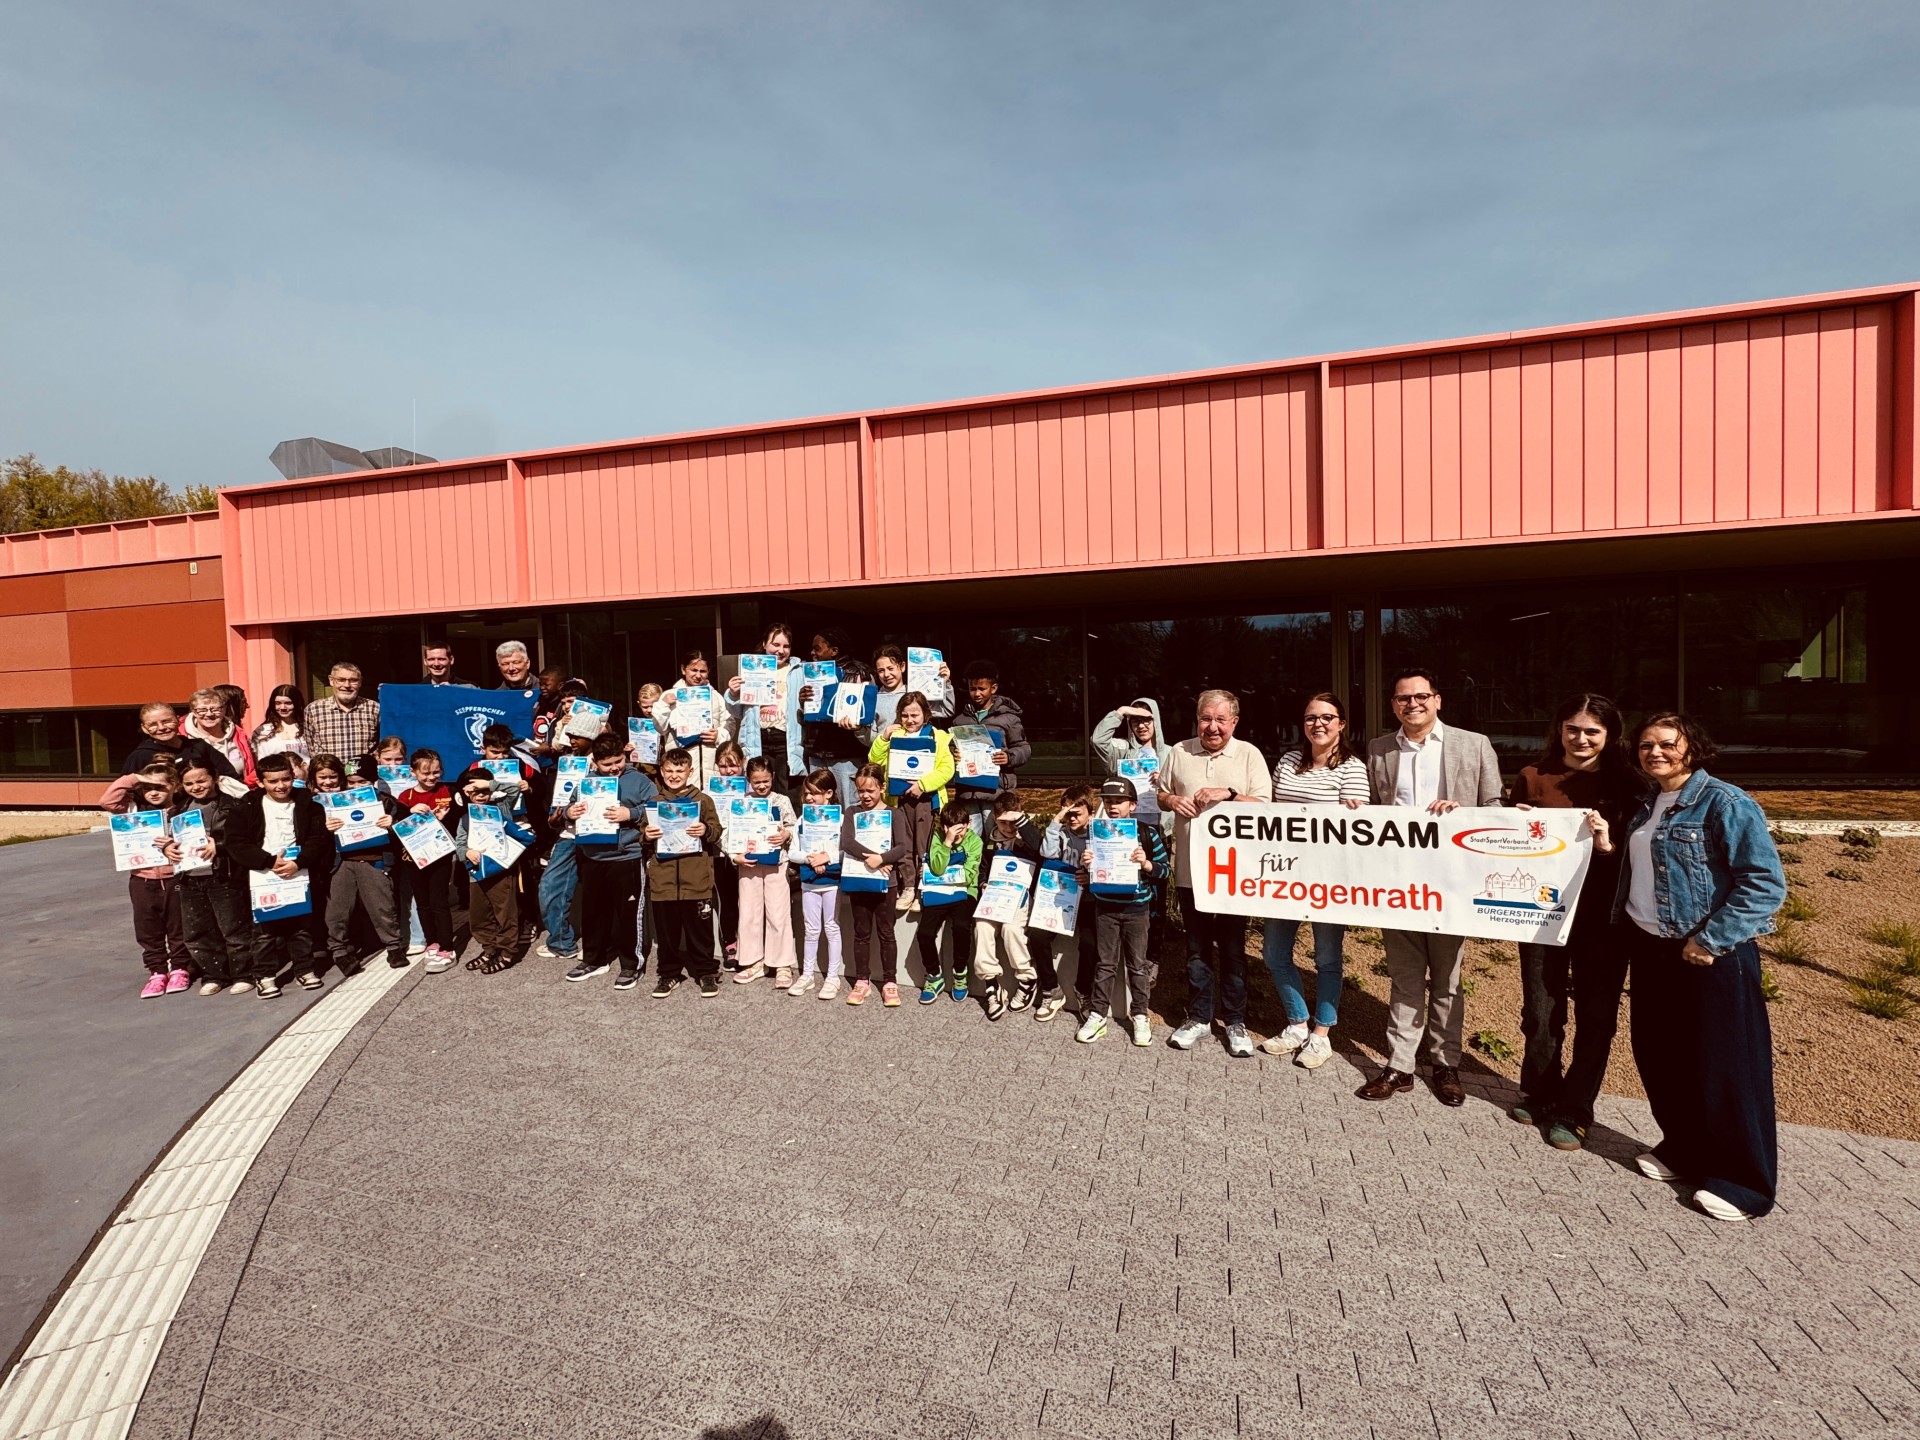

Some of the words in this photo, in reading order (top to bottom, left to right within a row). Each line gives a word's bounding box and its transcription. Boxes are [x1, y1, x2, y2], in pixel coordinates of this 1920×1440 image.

[455, 706, 506, 715] SEEPFERDCHEN
[1207, 814, 1440, 849] GEMEINSAM
[1470, 836, 1529, 844] StadtSportVerband
[1253, 852, 1299, 881] für
[1207, 845, 1443, 913] Herzogenrath
[1477, 907, 1561, 921] BÜRGERSTIFTUNG
[1489, 915, 1548, 926] Herzogenrath
